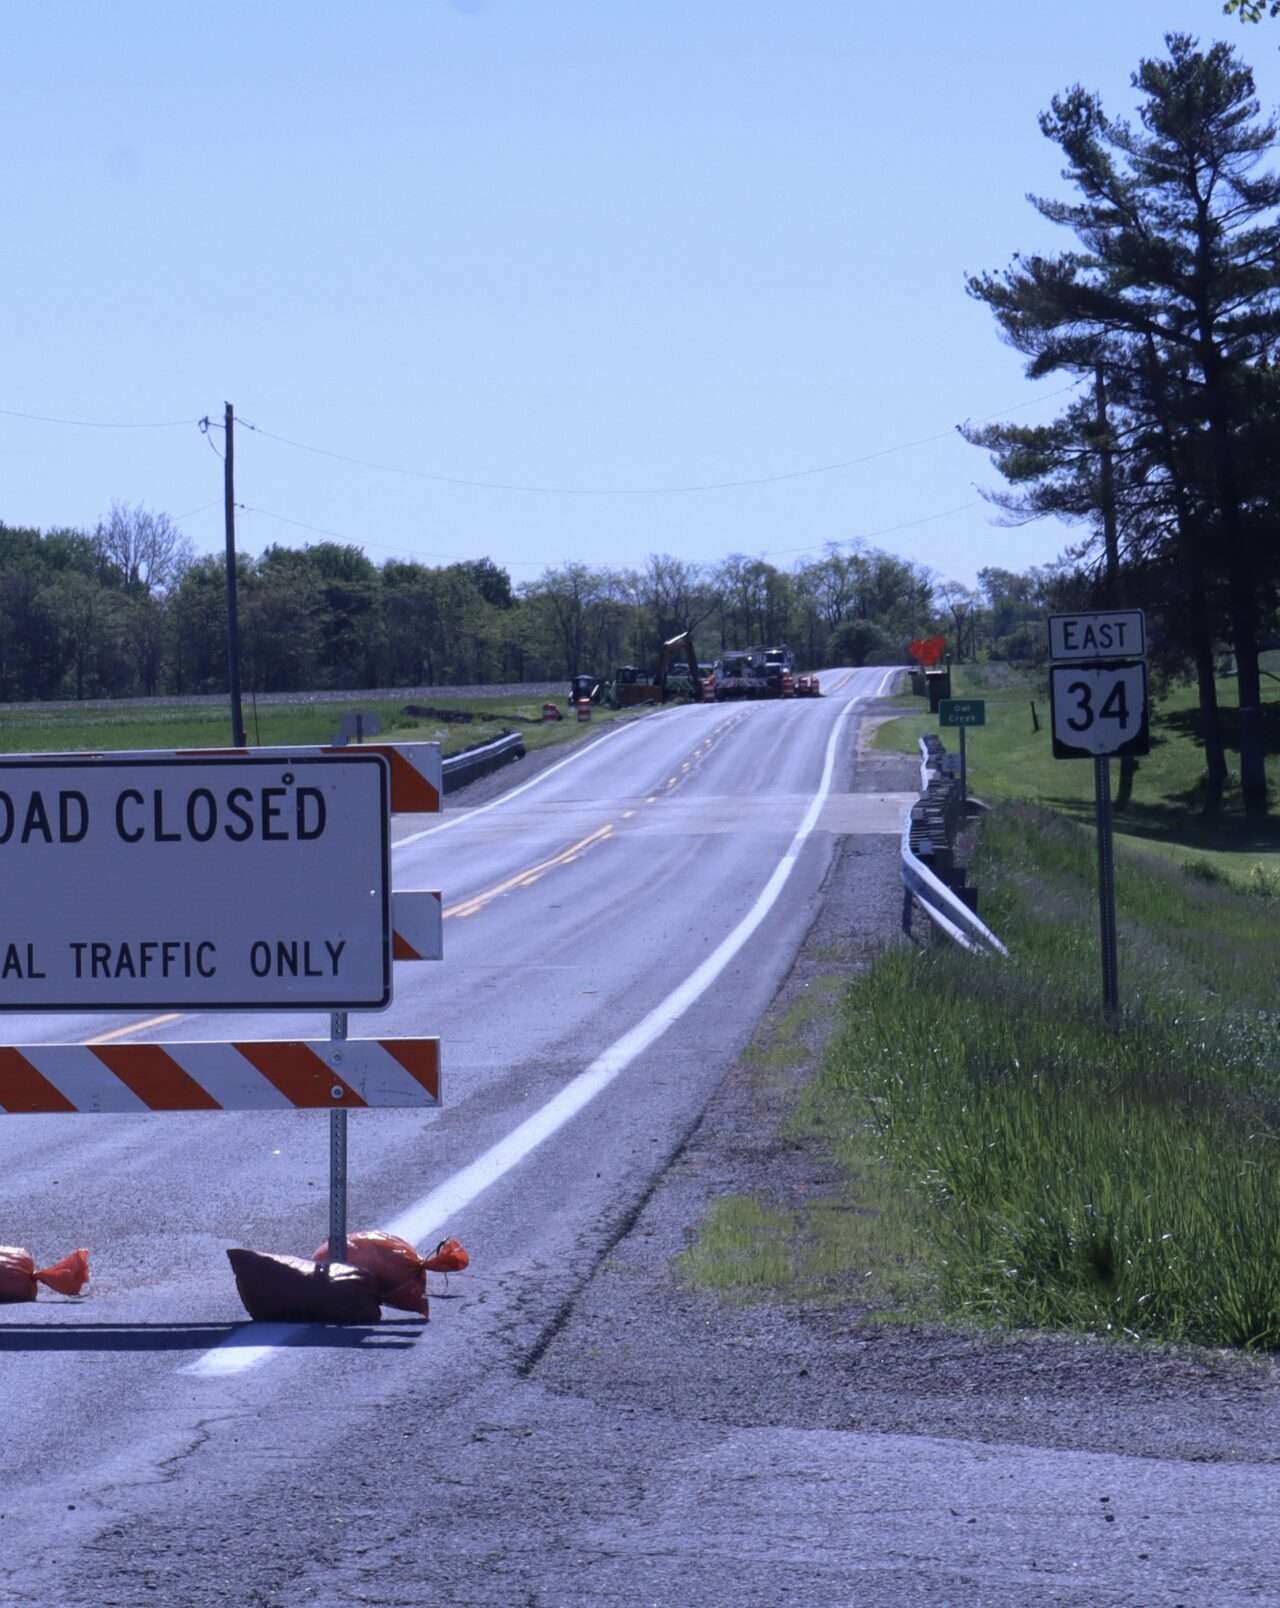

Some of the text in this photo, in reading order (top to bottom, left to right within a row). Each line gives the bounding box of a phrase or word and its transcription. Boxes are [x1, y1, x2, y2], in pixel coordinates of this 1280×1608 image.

[1062, 620, 1128, 651] EAST
[1066, 680, 1129, 731] 34
[115, 786, 327, 844] CLOSED
[69, 941, 217, 979] TRAFFIC
[250, 940, 346, 978] ONLY
